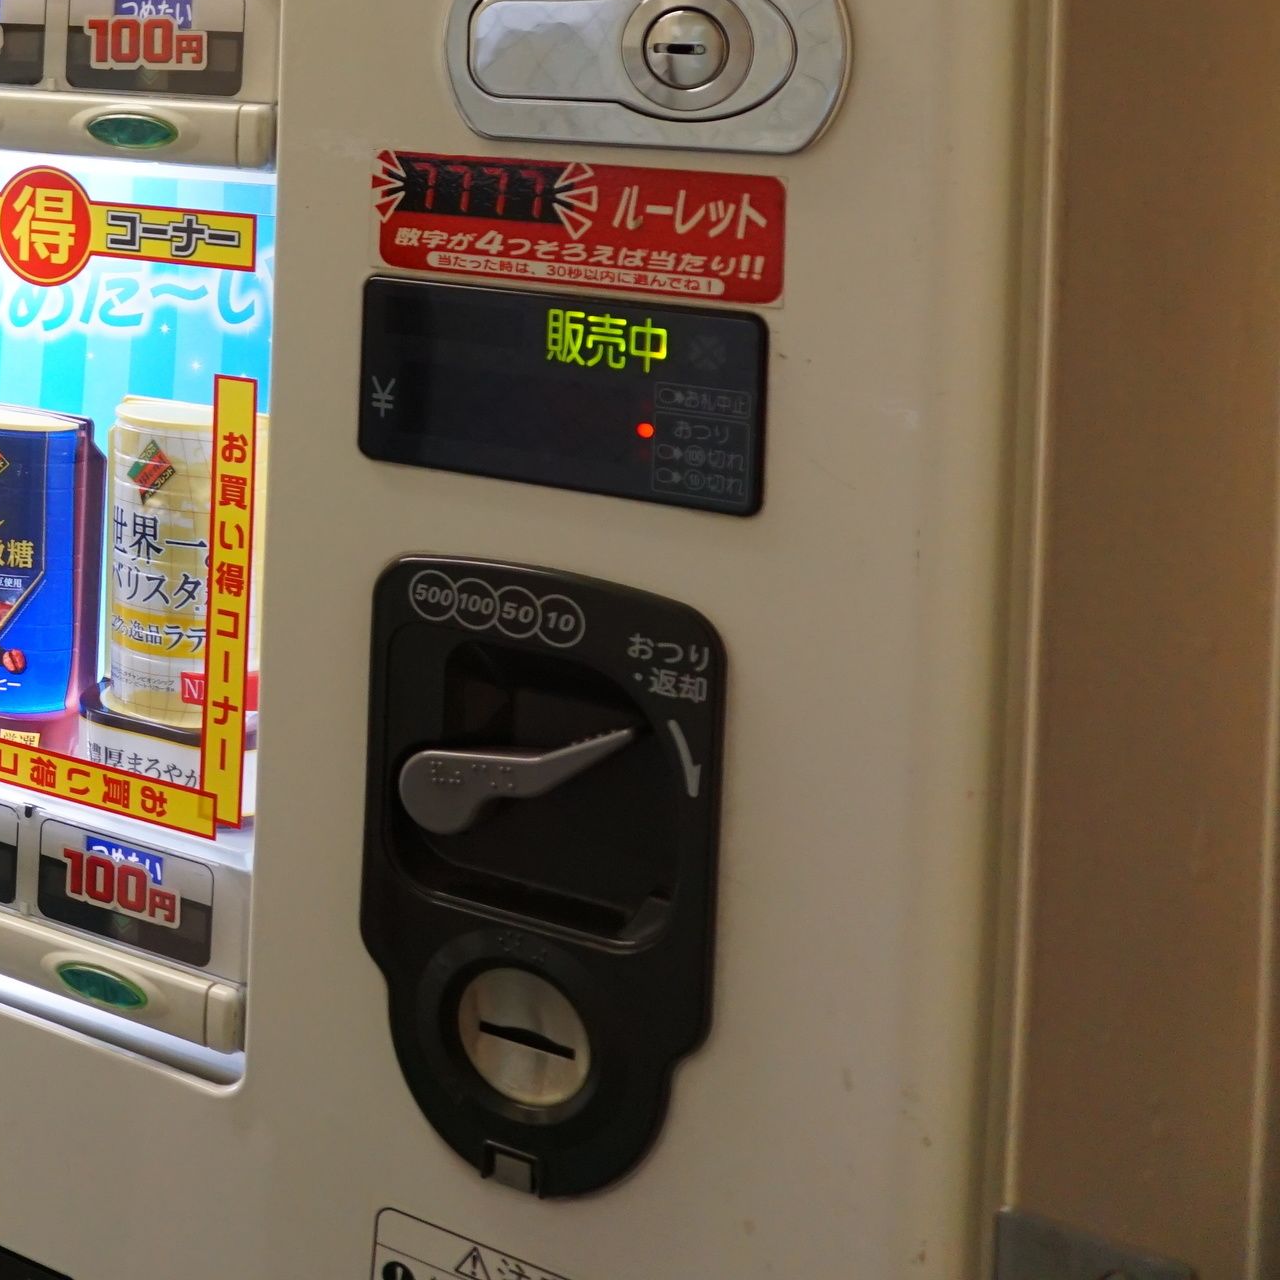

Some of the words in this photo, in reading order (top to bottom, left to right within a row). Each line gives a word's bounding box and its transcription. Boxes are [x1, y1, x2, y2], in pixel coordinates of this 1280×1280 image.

[87, 18, 204, 66] 100円
[11, 183, 77, 266] 得
[105, 210, 242, 258] コーナー
[415, 161, 547, 219] 7777
[612, 185, 768, 241] ルーレット
[393, 224, 765, 280] 数字が4つそろえば当たり!!
[436, 253, 716, 295] 当たった時は、30秒以内に選んでね!
[546, 306, 669, 374] 販売中
[370, 374, 396, 419] ¥
[113, 508, 210, 565] 世界一
[211, 432, 249, 771] お買い得コーナー
[414, 583, 453, 607] 500
[459, 591, 495, 615] 100
[501, 600, 535, 624] 50
[547, 609, 576, 632] 10
[626, 632, 711, 671] おつり
[63, 847, 176, 923] 100円
